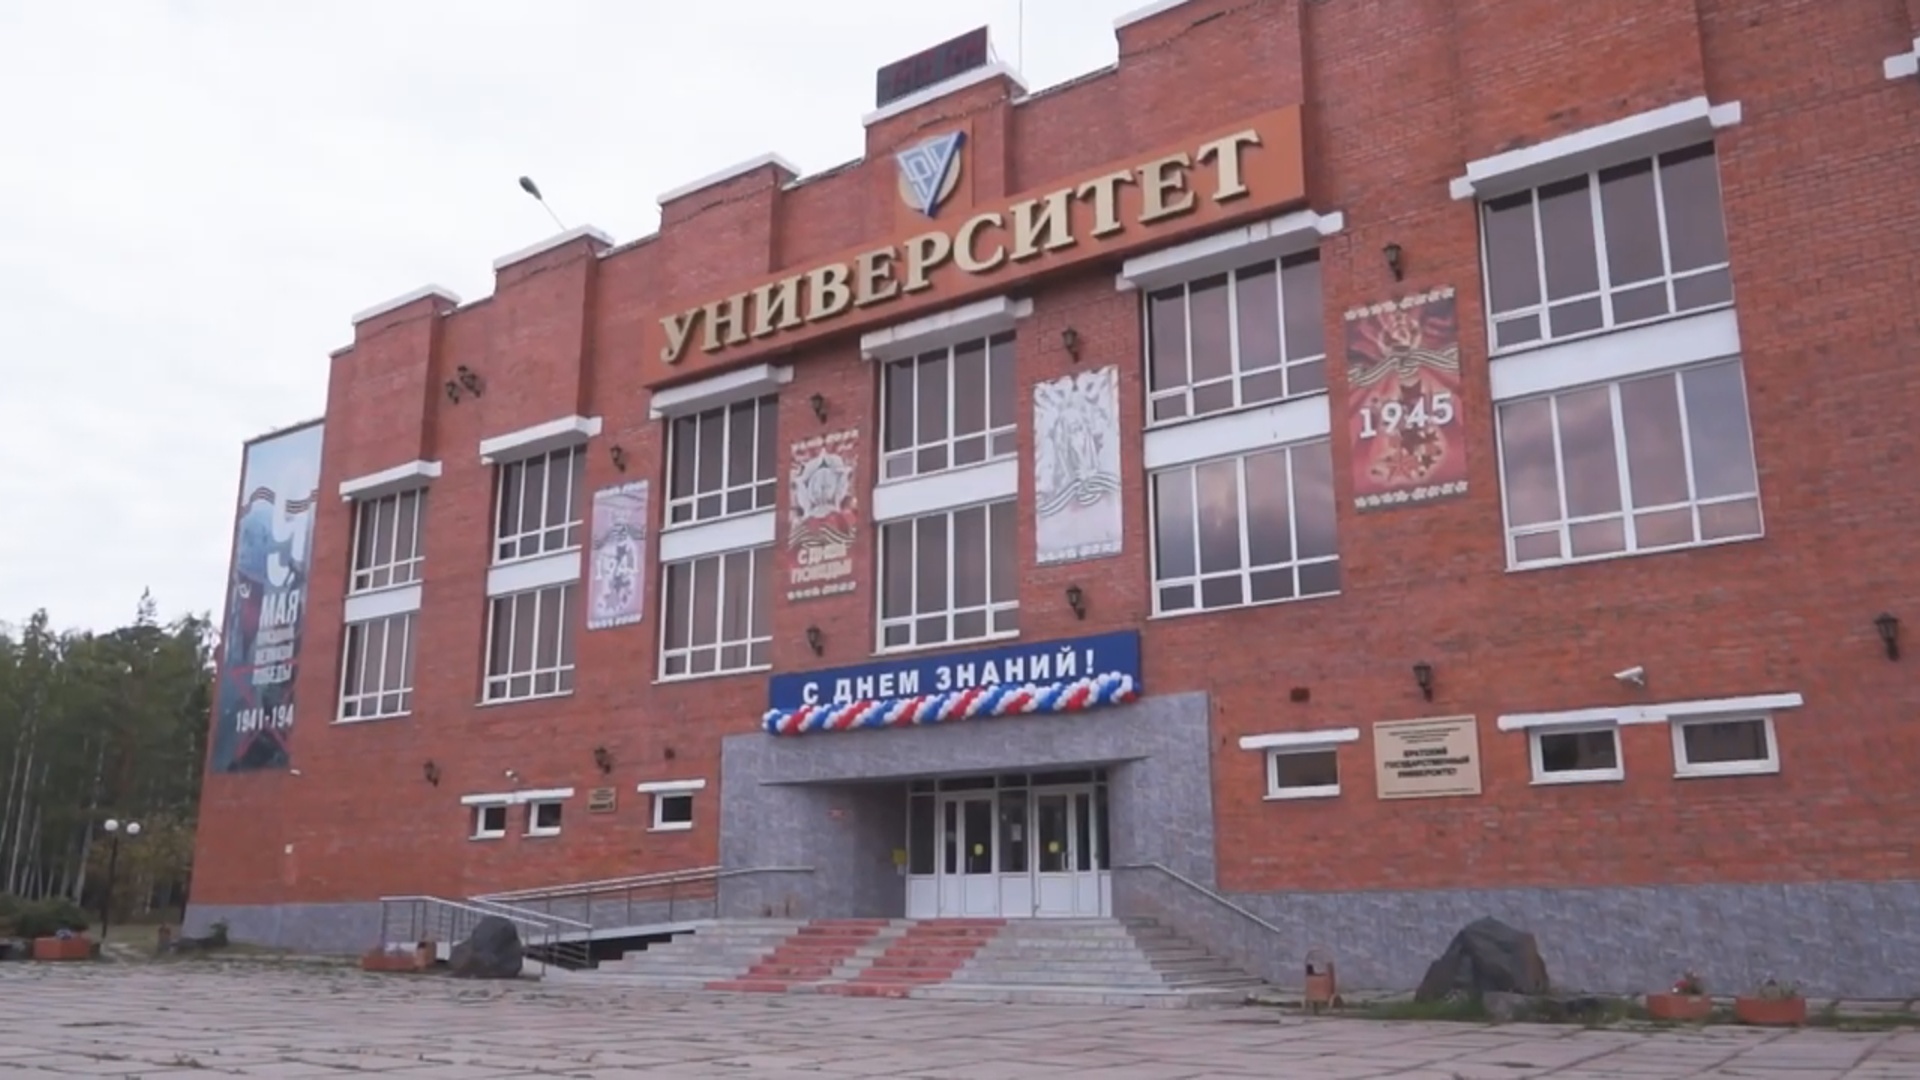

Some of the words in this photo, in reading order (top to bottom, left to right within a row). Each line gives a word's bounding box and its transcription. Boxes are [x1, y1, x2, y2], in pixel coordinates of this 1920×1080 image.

[660, 129, 1261, 364] УНИВЕРСИТЕТ
[1360, 393, 1453, 438] 1945
[258, 590, 299, 627] МАЯ
[803, 682, 818, 705] С
[834, 668, 919, 704] ДНЕМ
